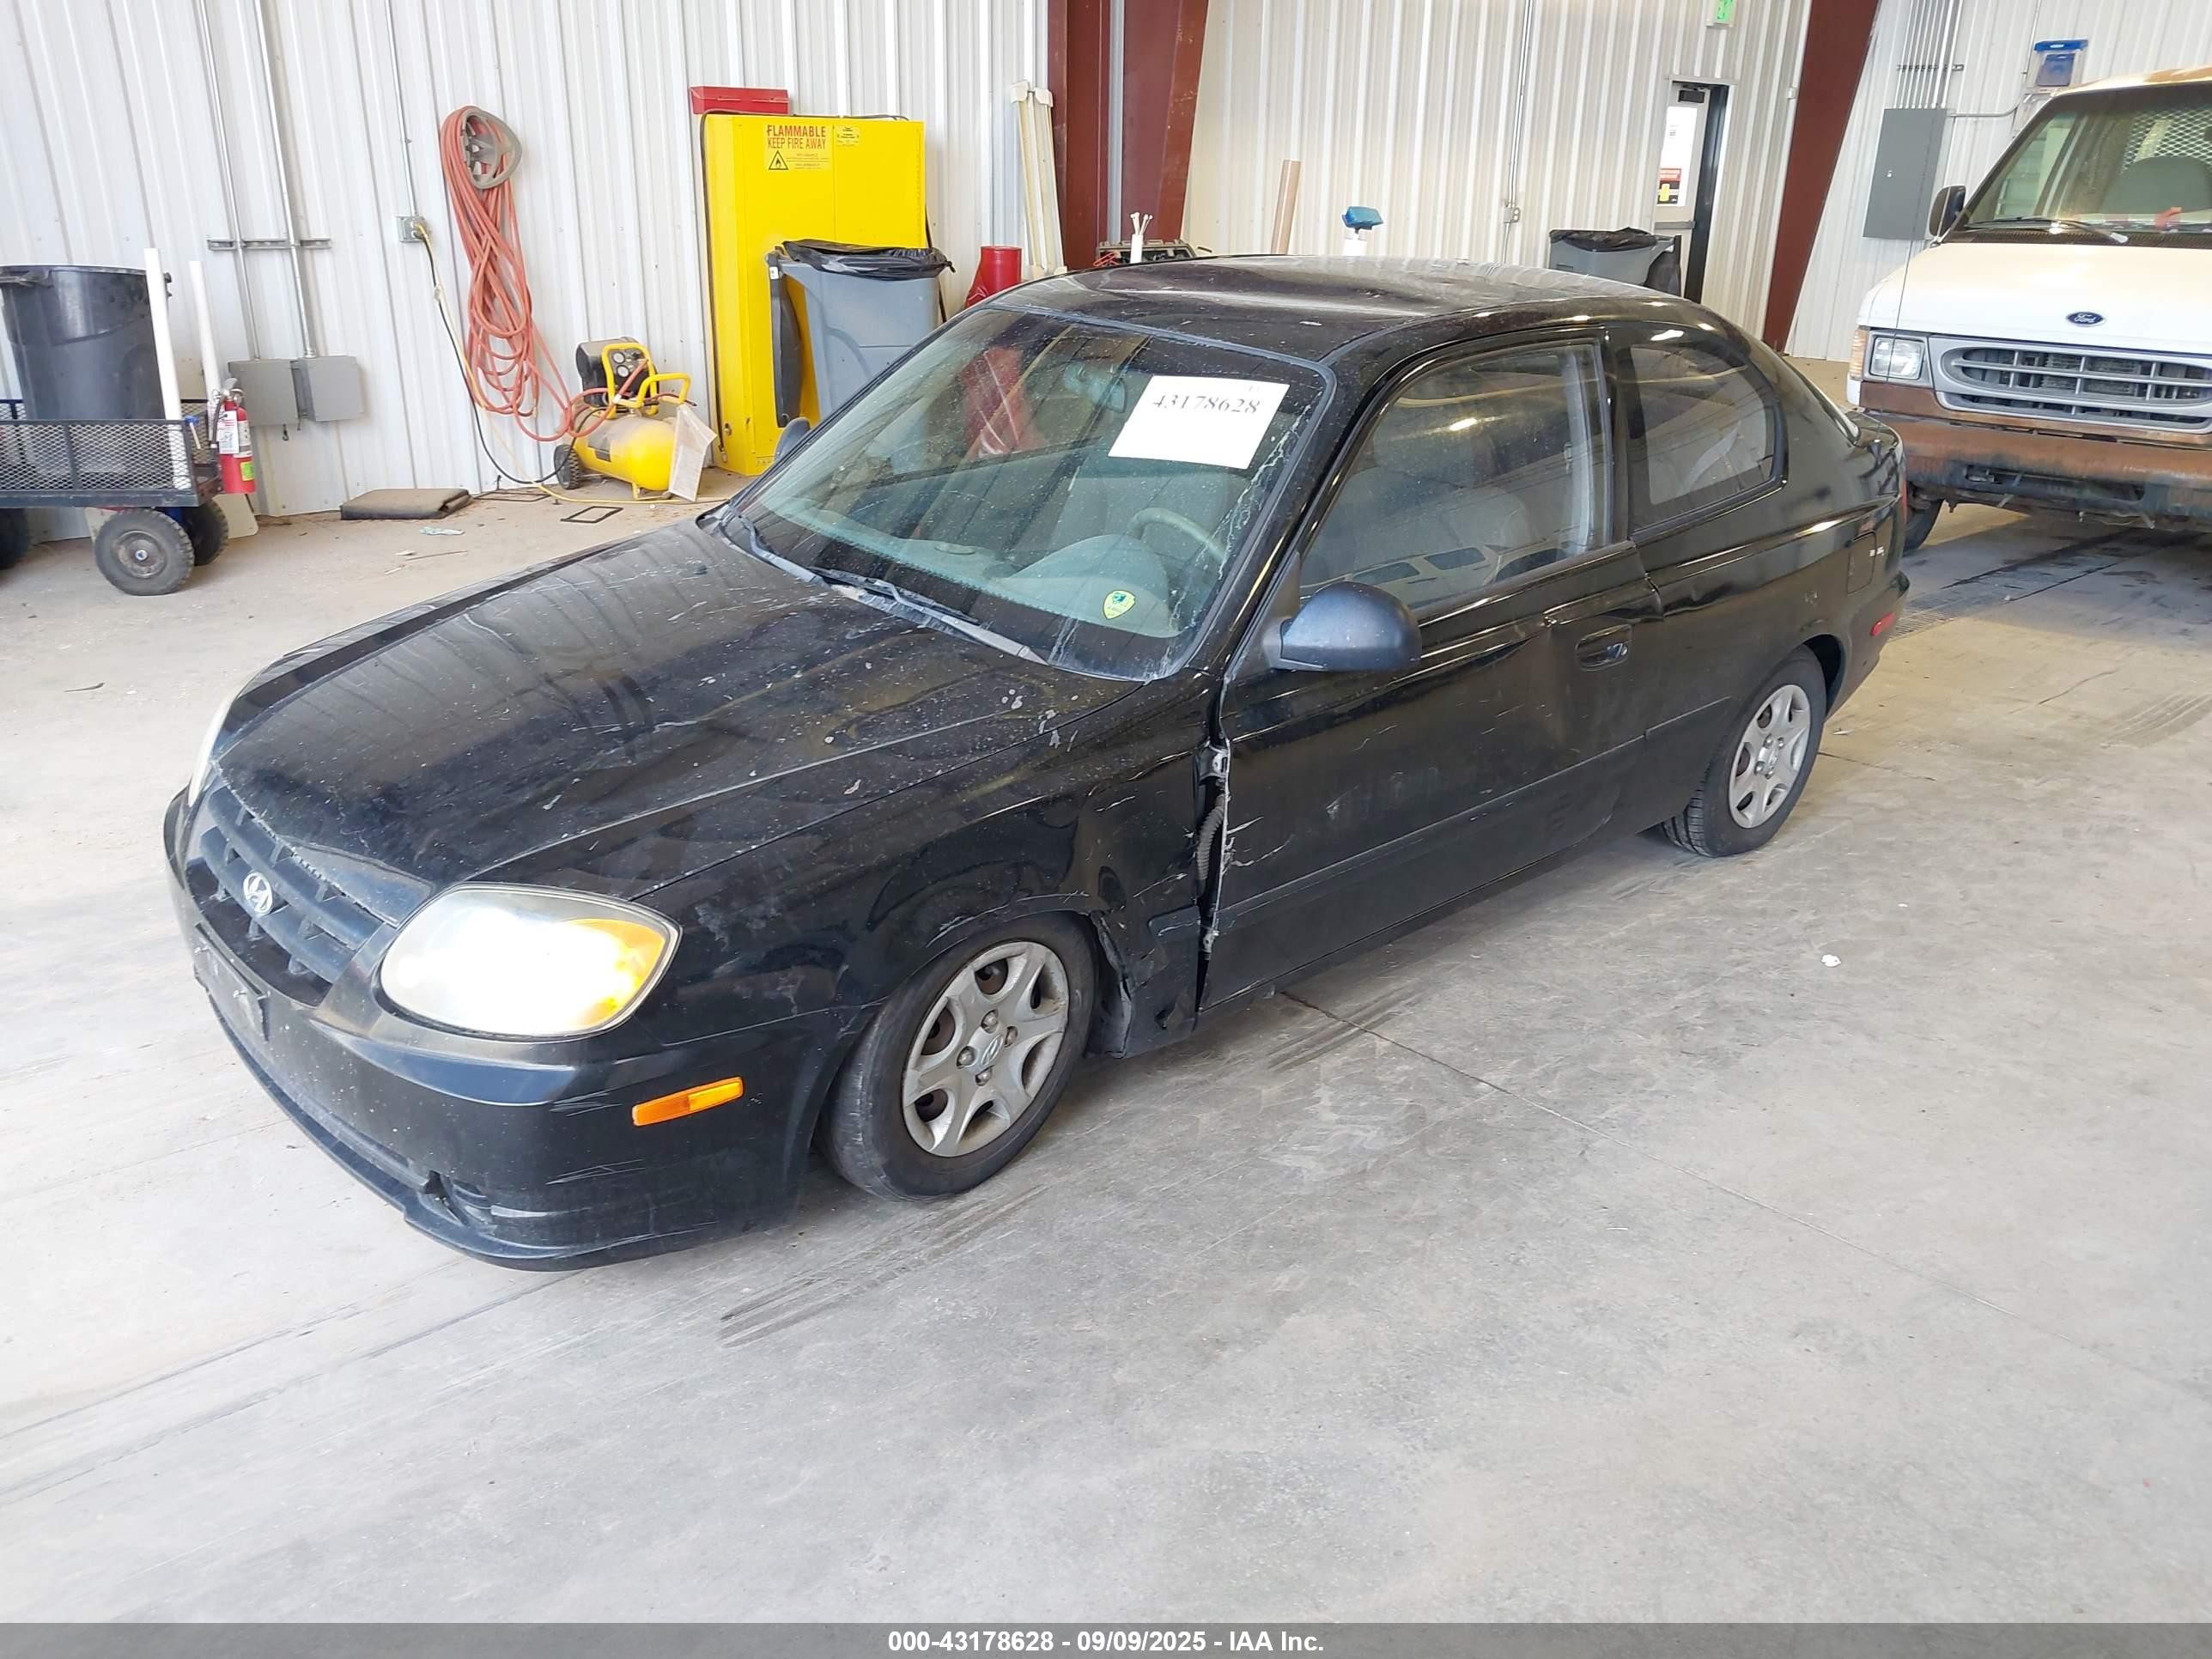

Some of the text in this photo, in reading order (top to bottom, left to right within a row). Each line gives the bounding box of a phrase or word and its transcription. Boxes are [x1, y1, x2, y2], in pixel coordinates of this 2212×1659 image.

[767, 125, 826, 137] FLAMMABLE
[768, 137, 826, 149] KEEP FIRE AWAY
[2074, 313, 2097, 323] Ford
[1152, 394, 1261, 414] 43178628
